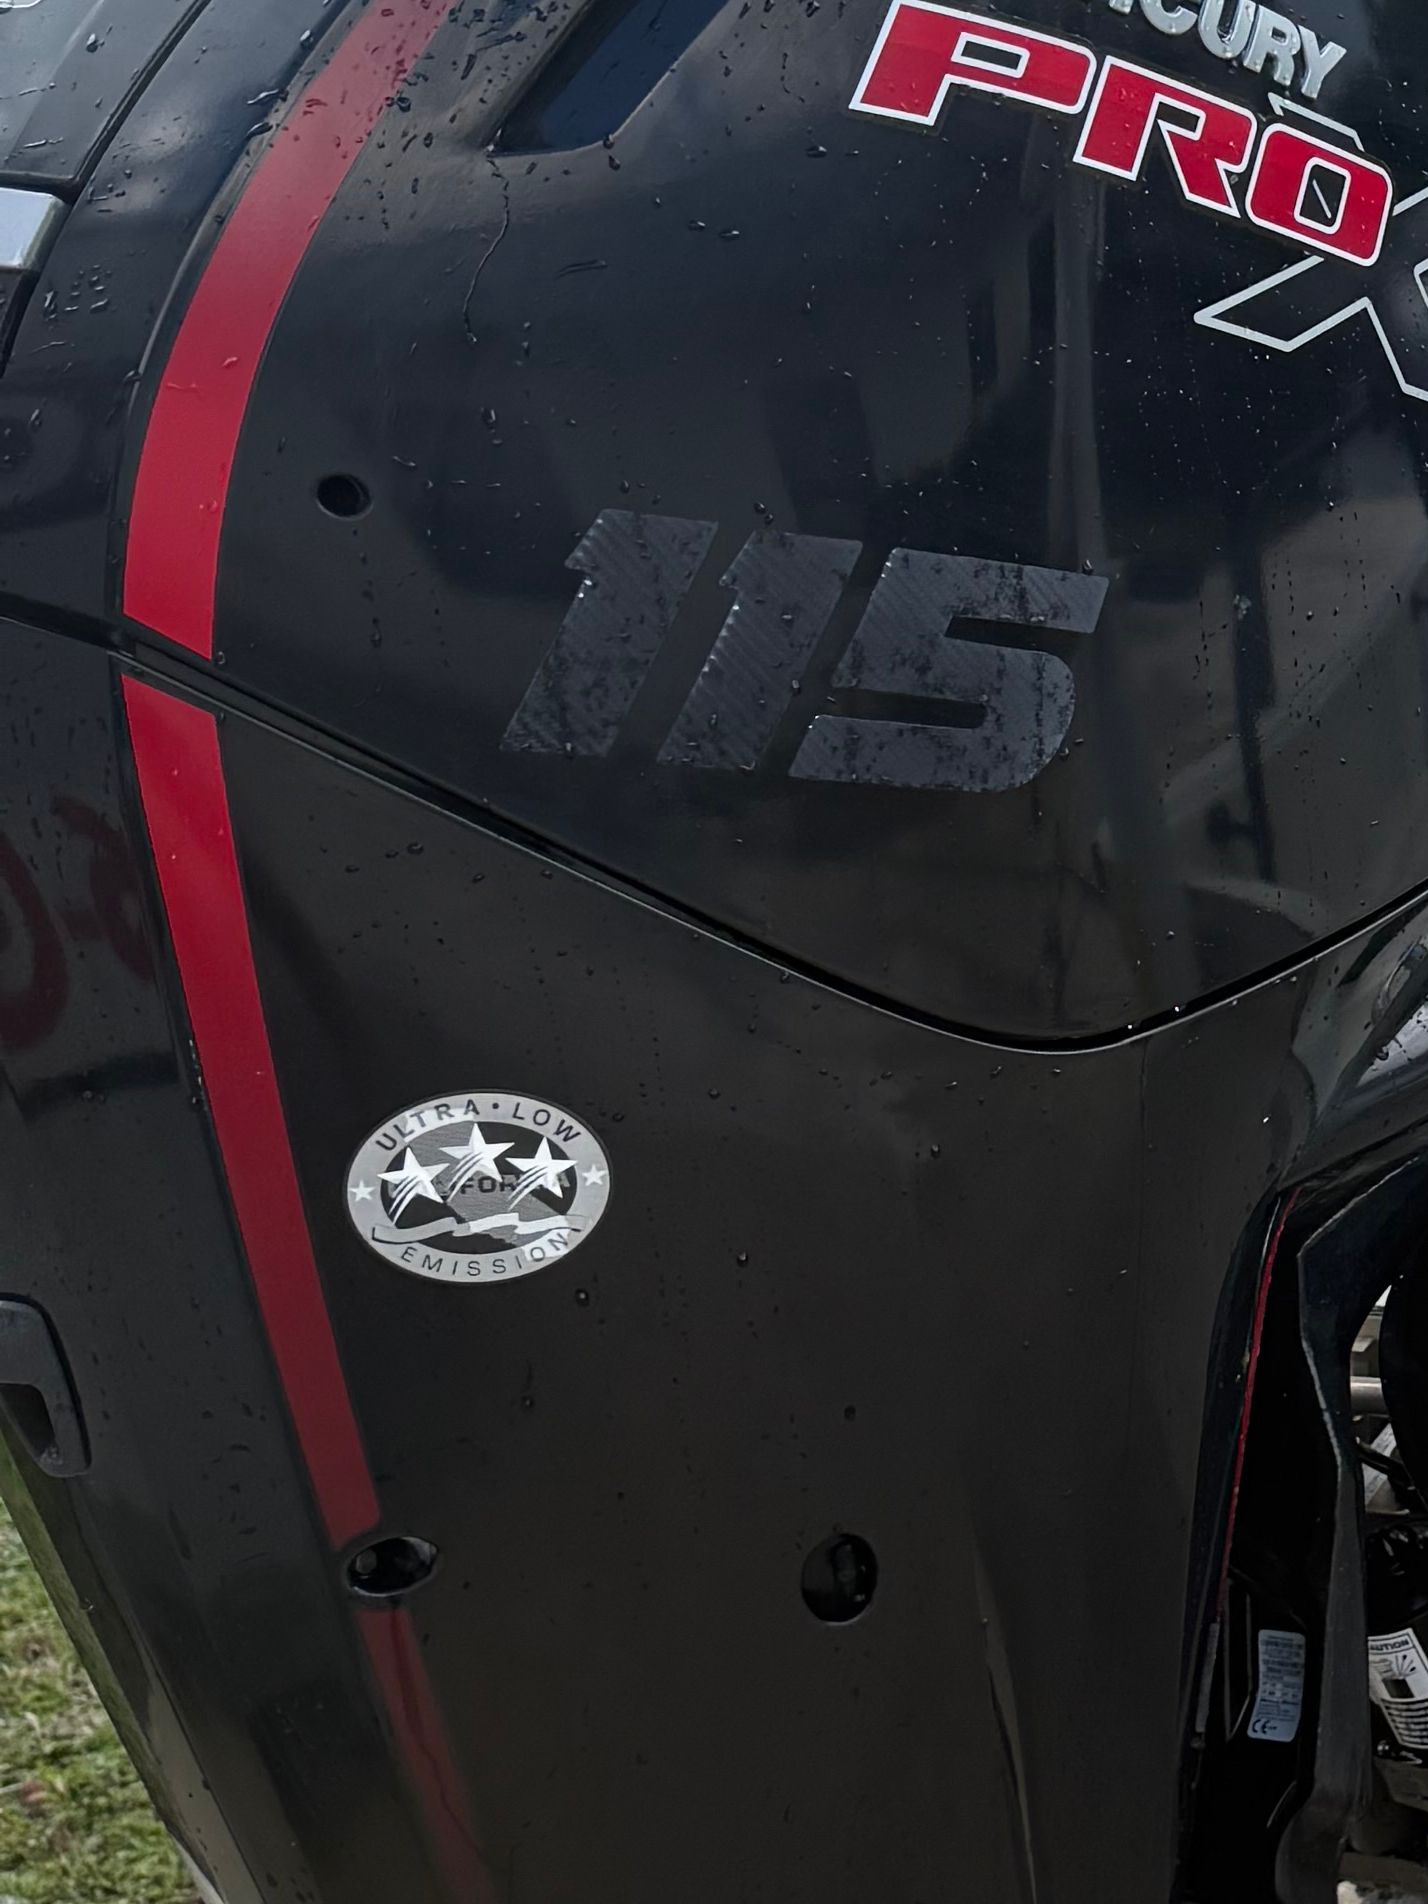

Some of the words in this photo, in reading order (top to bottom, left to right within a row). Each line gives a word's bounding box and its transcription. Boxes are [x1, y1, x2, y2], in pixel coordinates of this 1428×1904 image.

[501, 508, 1110, 792] 115
[376, 1099, 480, 1152] ULTRA
[512, 1100, 582, 1144] LOW
[400, 1233, 570, 1277] EMISSION
